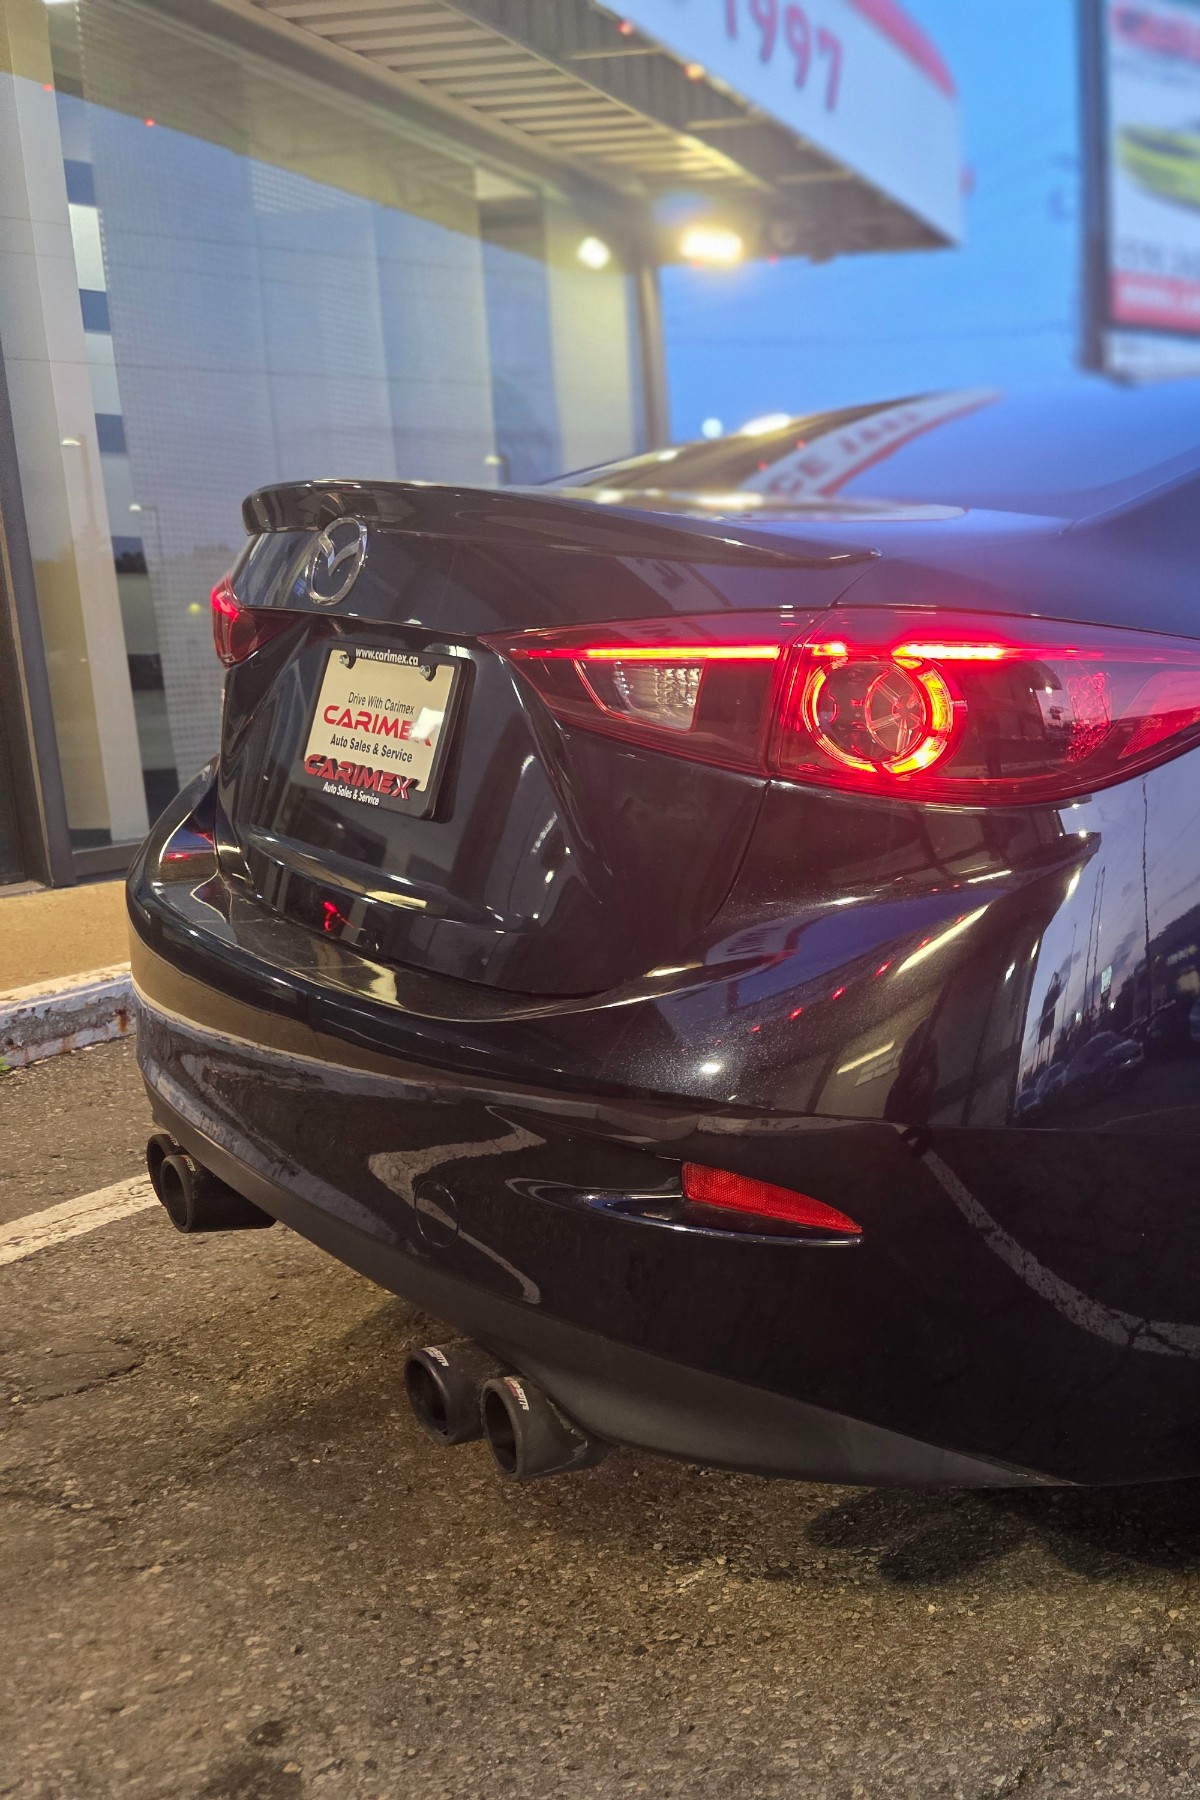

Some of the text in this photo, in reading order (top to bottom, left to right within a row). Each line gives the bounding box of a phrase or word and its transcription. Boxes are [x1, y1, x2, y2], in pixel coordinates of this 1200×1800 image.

[355, 648, 419, 666] www.carimex.ca
[348, 692, 415, 715] Drive With Carimex
[324, 705, 432, 747] CARIME
[330, 734, 413, 763] Auto Sales & Service
[304, 753, 414, 800] CARIMEX
[323, 782, 337, 795] Auto
[336, 784, 352, 798] Sales
[358, 790, 380, 806] Service
